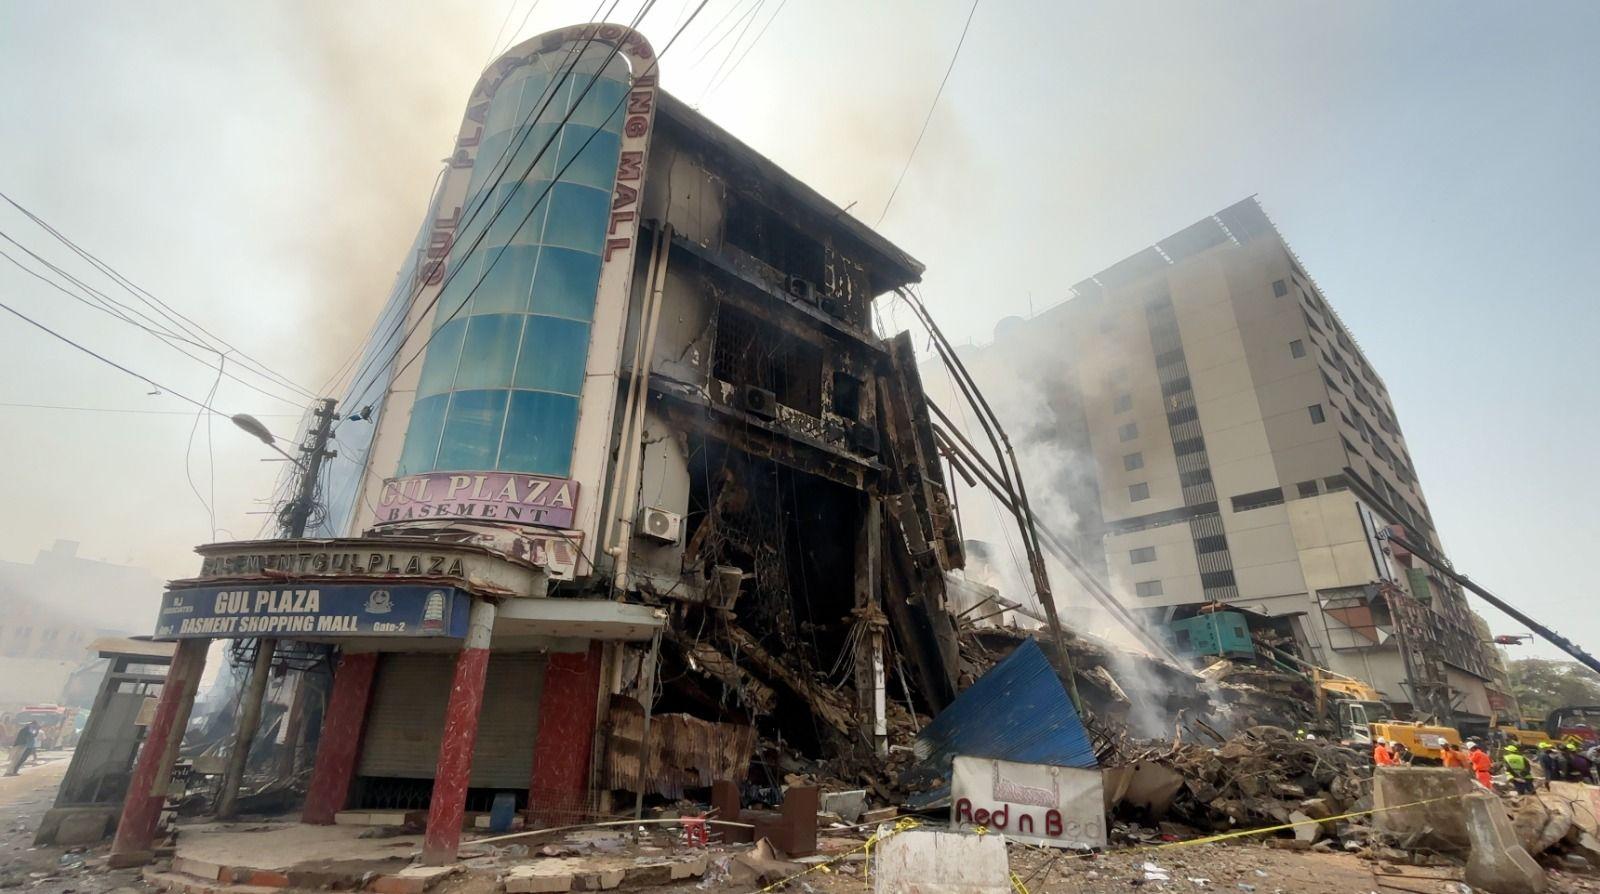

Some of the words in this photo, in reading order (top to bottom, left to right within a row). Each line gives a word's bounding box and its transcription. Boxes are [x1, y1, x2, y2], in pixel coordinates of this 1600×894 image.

[421, 207, 461, 286] GUL
[604, 151, 644, 262] MALL
[381, 478, 433, 506] GUL
[444, 475, 573, 510] PLAZA
[389, 503, 549, 522] BASEMENT
[214, 591, 250, 614] GUL
[255, 590, 320, 613] PLAZA
[180, 617, 238, 634] BASMENT
[239, 615, 315, 633] SHOPPING
[316, 615, 358, 632] MALL
[373, 622, 406, 632] Gate-2
[956, 798, 1009, 830] Red
[1019, 813, 1034, 833] n
